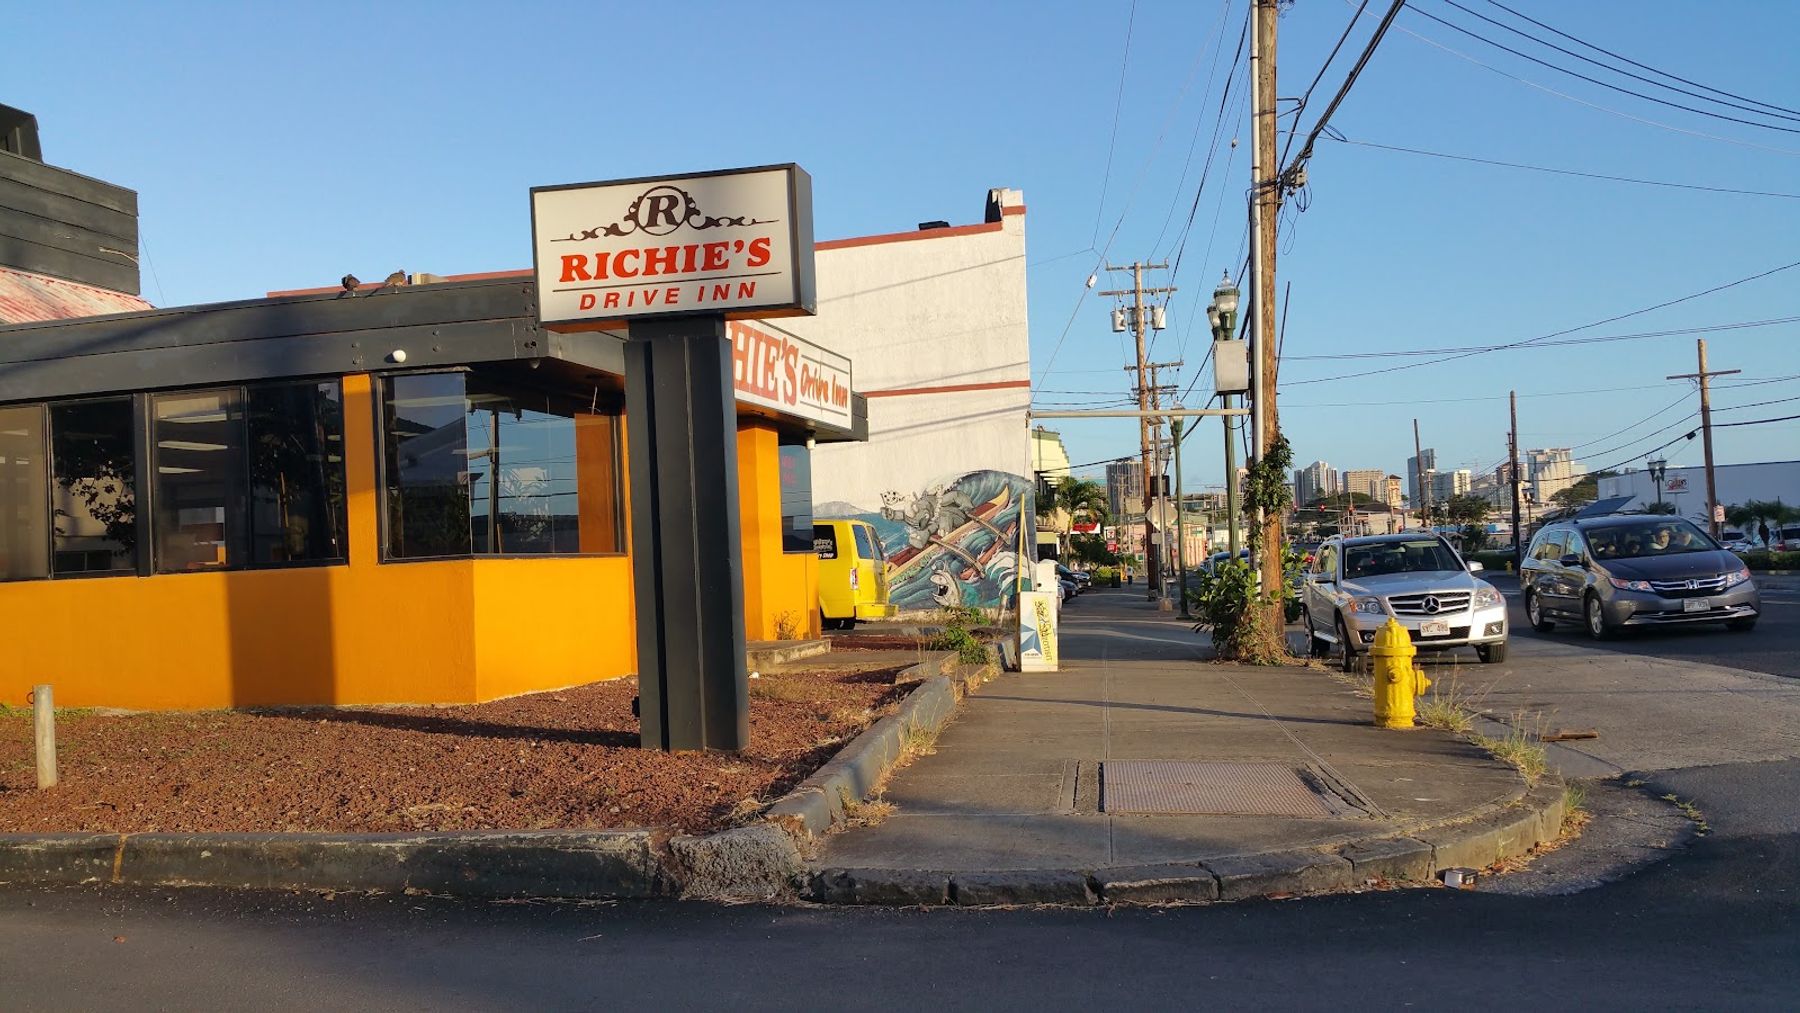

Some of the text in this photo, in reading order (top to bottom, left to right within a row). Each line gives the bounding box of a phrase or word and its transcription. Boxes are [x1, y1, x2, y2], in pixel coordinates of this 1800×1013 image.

[646, 194, 680, 228] R
[559, 237, 771, 283] RICHIE'S
[579, 281, 758, 311] DRIVE INN
[731, 320, 849, 409] HIE'S Drive Inn
